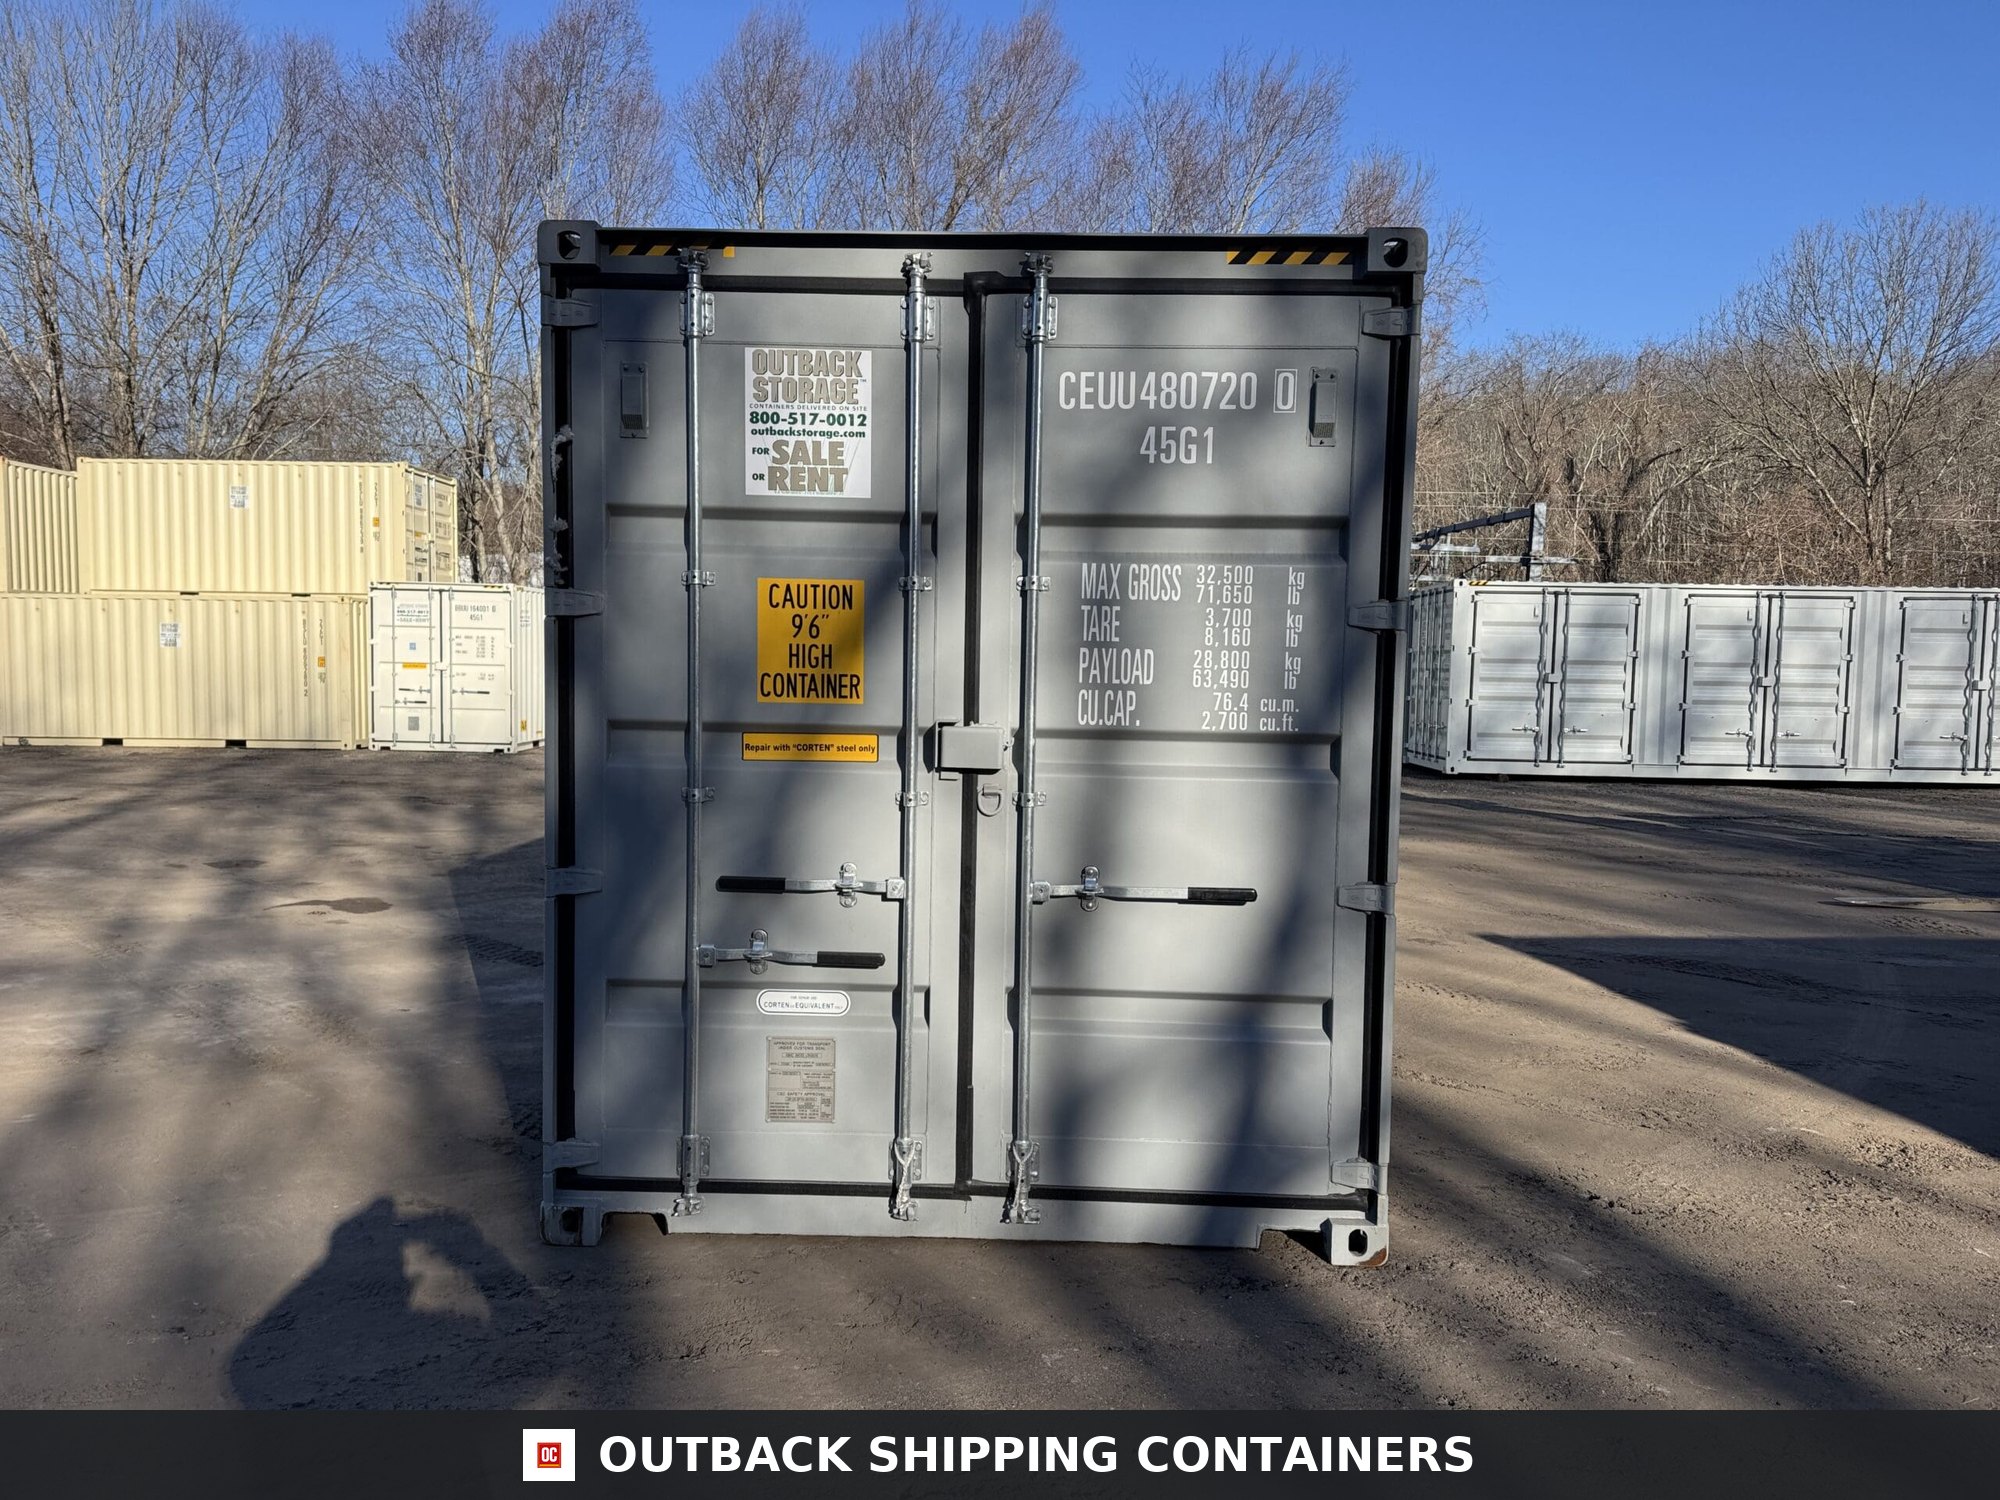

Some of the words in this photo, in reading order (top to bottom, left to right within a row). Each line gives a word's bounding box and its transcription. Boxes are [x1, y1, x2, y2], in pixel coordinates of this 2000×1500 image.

[752, 349, 863, 377] OUTBACK
[752, 376, 859, 404] STORAGE
[1276, 372, 1294, 410] 0
[749, 411, 868, 427] 800-517-0012
[750, 426, 866, 439] outbackstorage.com
[752, 447, 770, 455] FOR
[771, 439, 845, 466] SALE
[1140, 426, 1214, 464] 45G1
[752, 472, 765, 481] OR
[767, 466, 849, 492] RENT
[1081, 563, 1121, 599] MAX
[1128, 564, 1182, 601] GROSS
[1196, 565, 1253, 585] 32,500
[1288, 566, 1305, 589] kg
[1196, 585, 1253, 605] 71,650
[1287, 586, 1300, 605] lb
[768, 583, 853, 610] CAUTION
[1081, 605, 1121, 642] TARE
[1205, 608, 1252, 628] 3,700
[1286, 609, 1303, 632] kg
[1204, 628, 1251, 647] 8,160
[1285, 629, 1299, 648] lb
[788, 643, 833, 669] HIGH
[1078, 647, 1154, 685] PAYLOAD
[1193, 649, 1250, 670] 28,800
[1284, 651, 1302, 674] kg
[760, 672, 861, 699] CONTAINER
[1192, 670, 1250, 690] 63,490
[1284, 671, 1297, 690] lb
[1077, 689, 1140, 727] CU.CAP.
[1213, 692, 1249, 711] 76.4
[1259, 698, 1300, 713] cu.m.
[1201, 711, 1248, 731] 2,700
[1259, 713, 1299, 732] cu.ft.
[744, 743, 771, 752] Repair
[773, 743, 791, 752] with
[836, 744, 856, 752] steel
[858, 744, 876, 754] only
